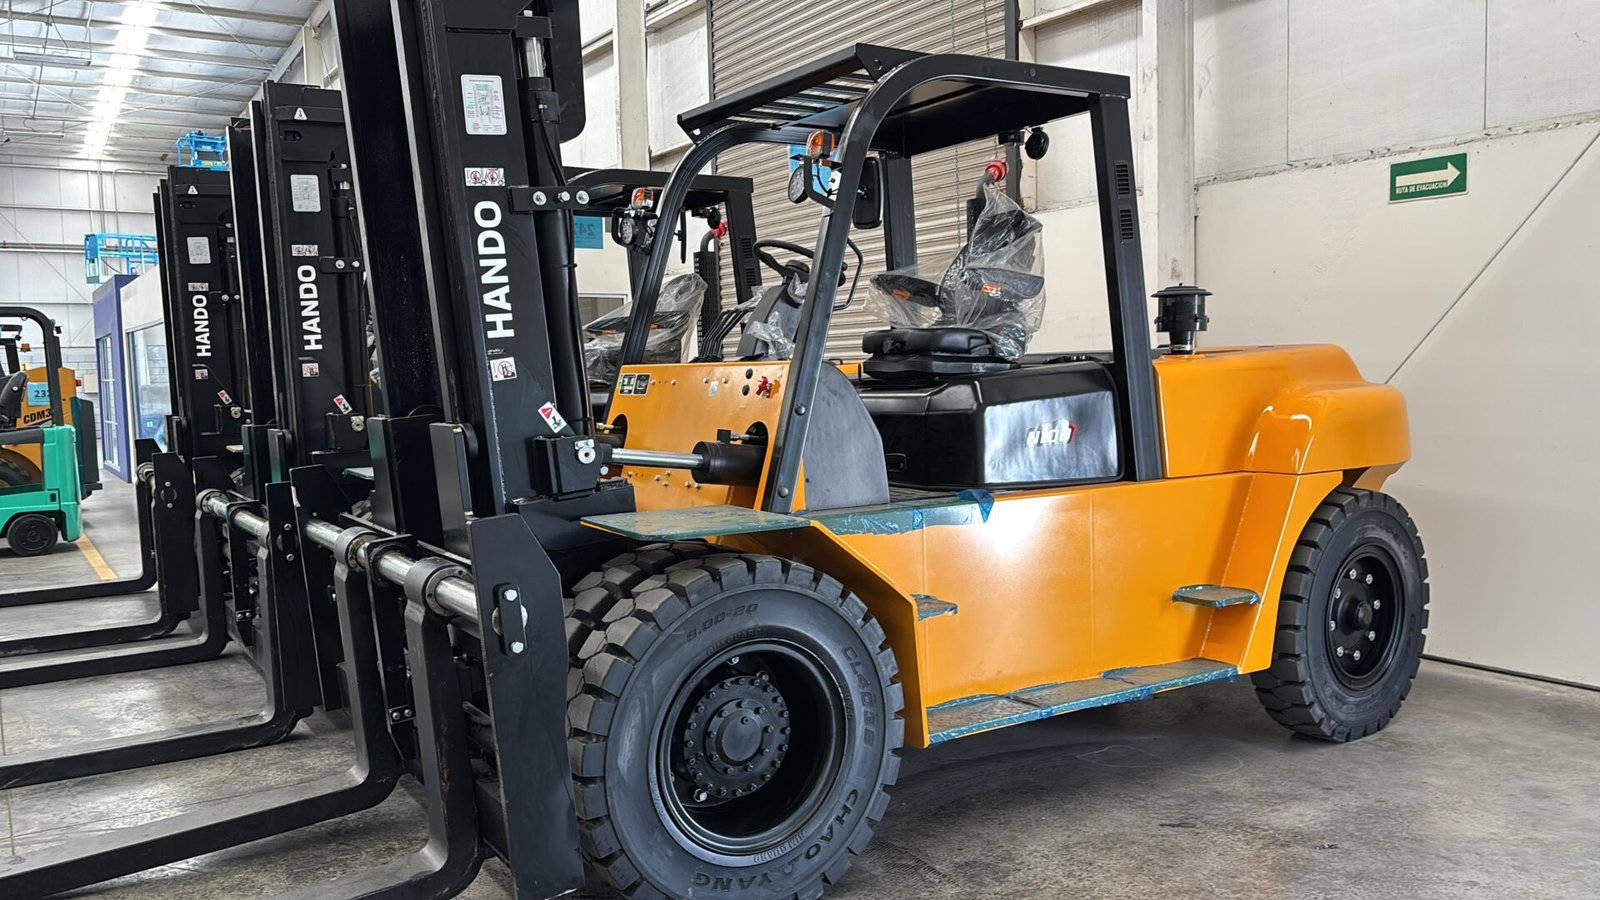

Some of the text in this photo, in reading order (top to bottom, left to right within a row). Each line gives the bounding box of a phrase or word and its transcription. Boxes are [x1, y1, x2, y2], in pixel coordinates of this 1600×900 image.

[1395, 186, 1408, 194] RUTA
[1409, 185, 1416, 193] DE
[474, 200, 515, 339] HANDO
[192, 294, 212, 357] HANDO
[297, 265, 323, 351] HANDO
[686, 603, 759, 643] 9.00-20
